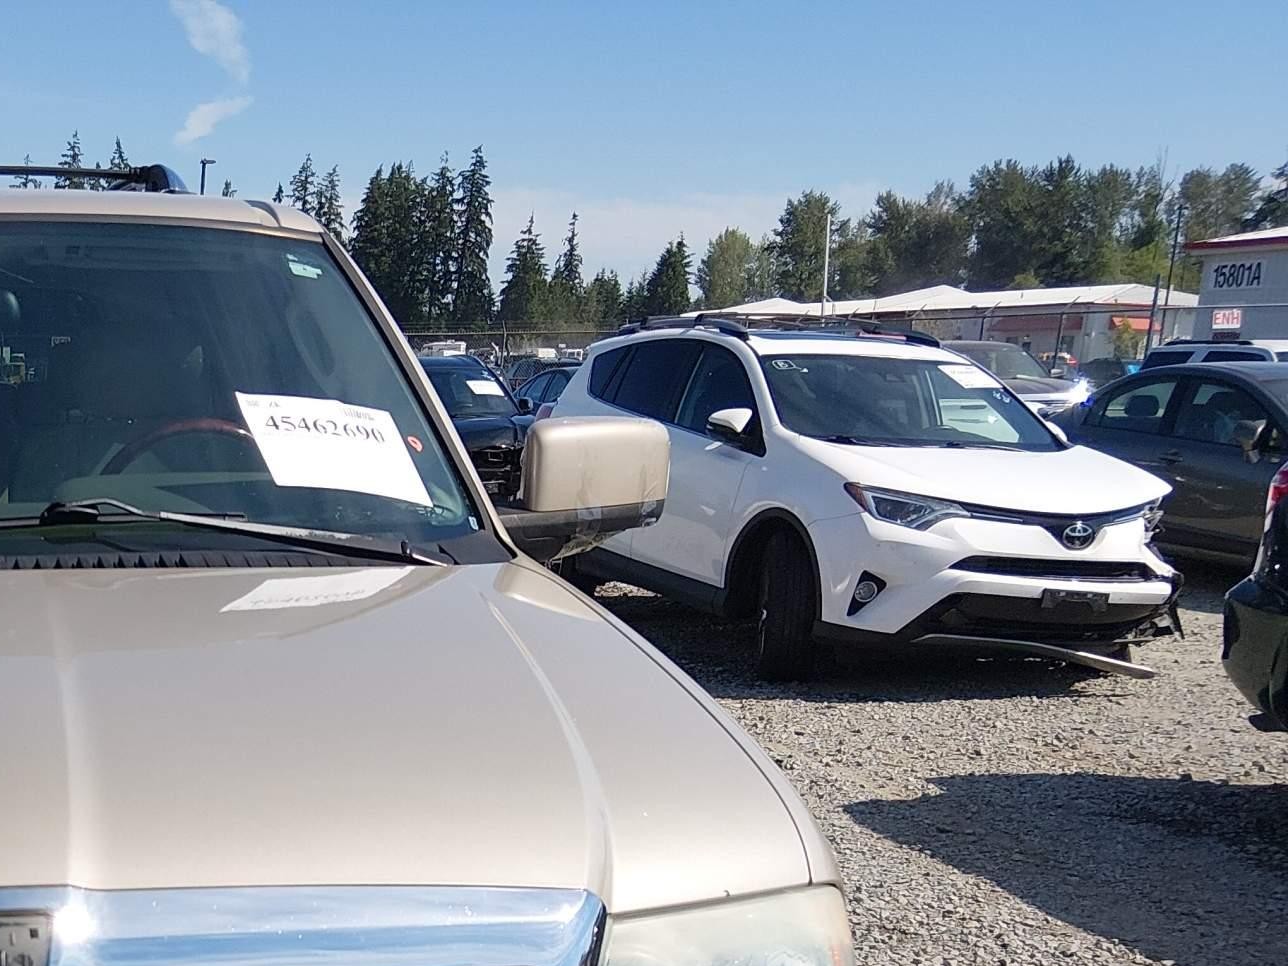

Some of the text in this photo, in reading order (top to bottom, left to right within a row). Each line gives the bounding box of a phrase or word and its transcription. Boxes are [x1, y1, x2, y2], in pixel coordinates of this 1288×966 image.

[1213, 262, 1262, 289] 15801A
[1214, 312, 1240, 325] ENH
[265, 415, 385, 443] 45462690
